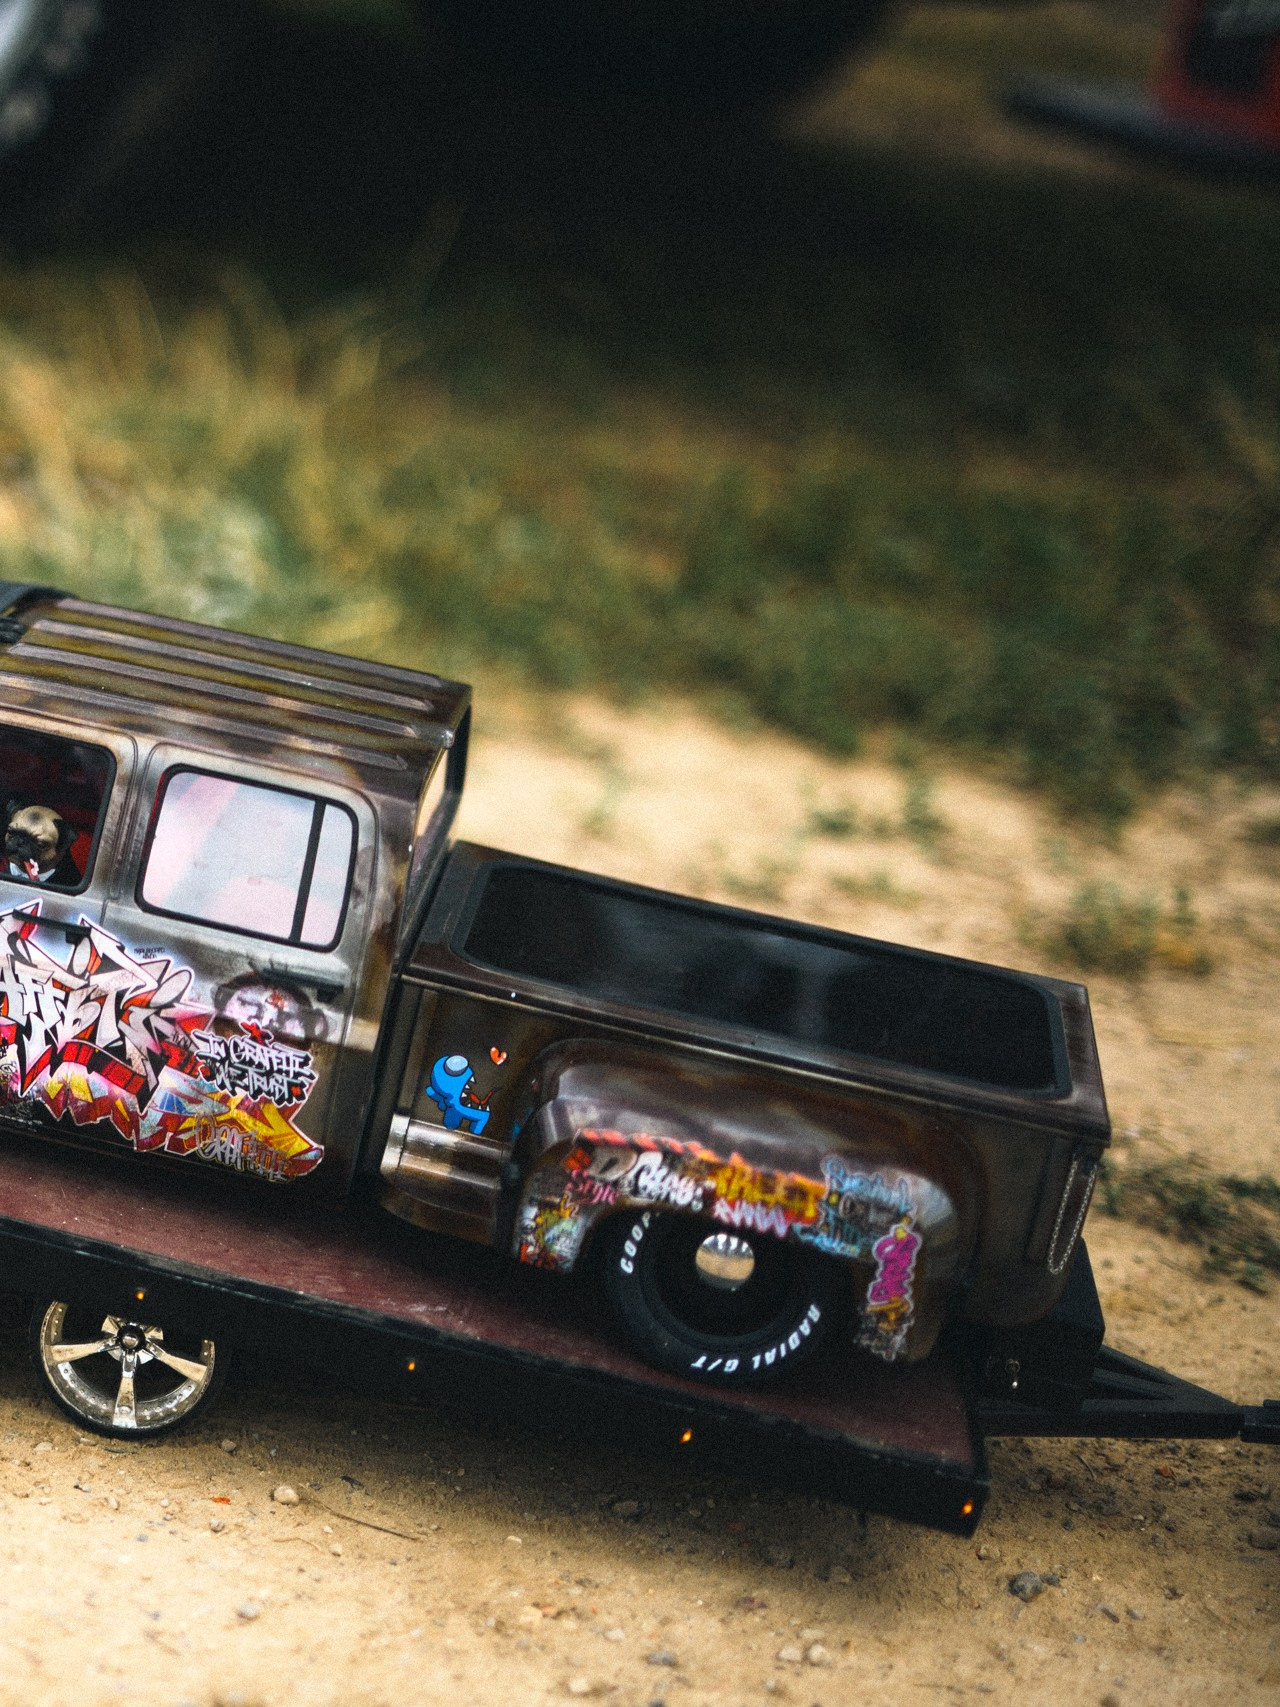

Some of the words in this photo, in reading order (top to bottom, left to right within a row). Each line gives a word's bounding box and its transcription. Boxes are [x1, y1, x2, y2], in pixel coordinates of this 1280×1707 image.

[620, 1211, 651, 1274] COOP
[691, 1355, 739, 1373] G/T
[752, 1304, 821, 1370] RADIAL
